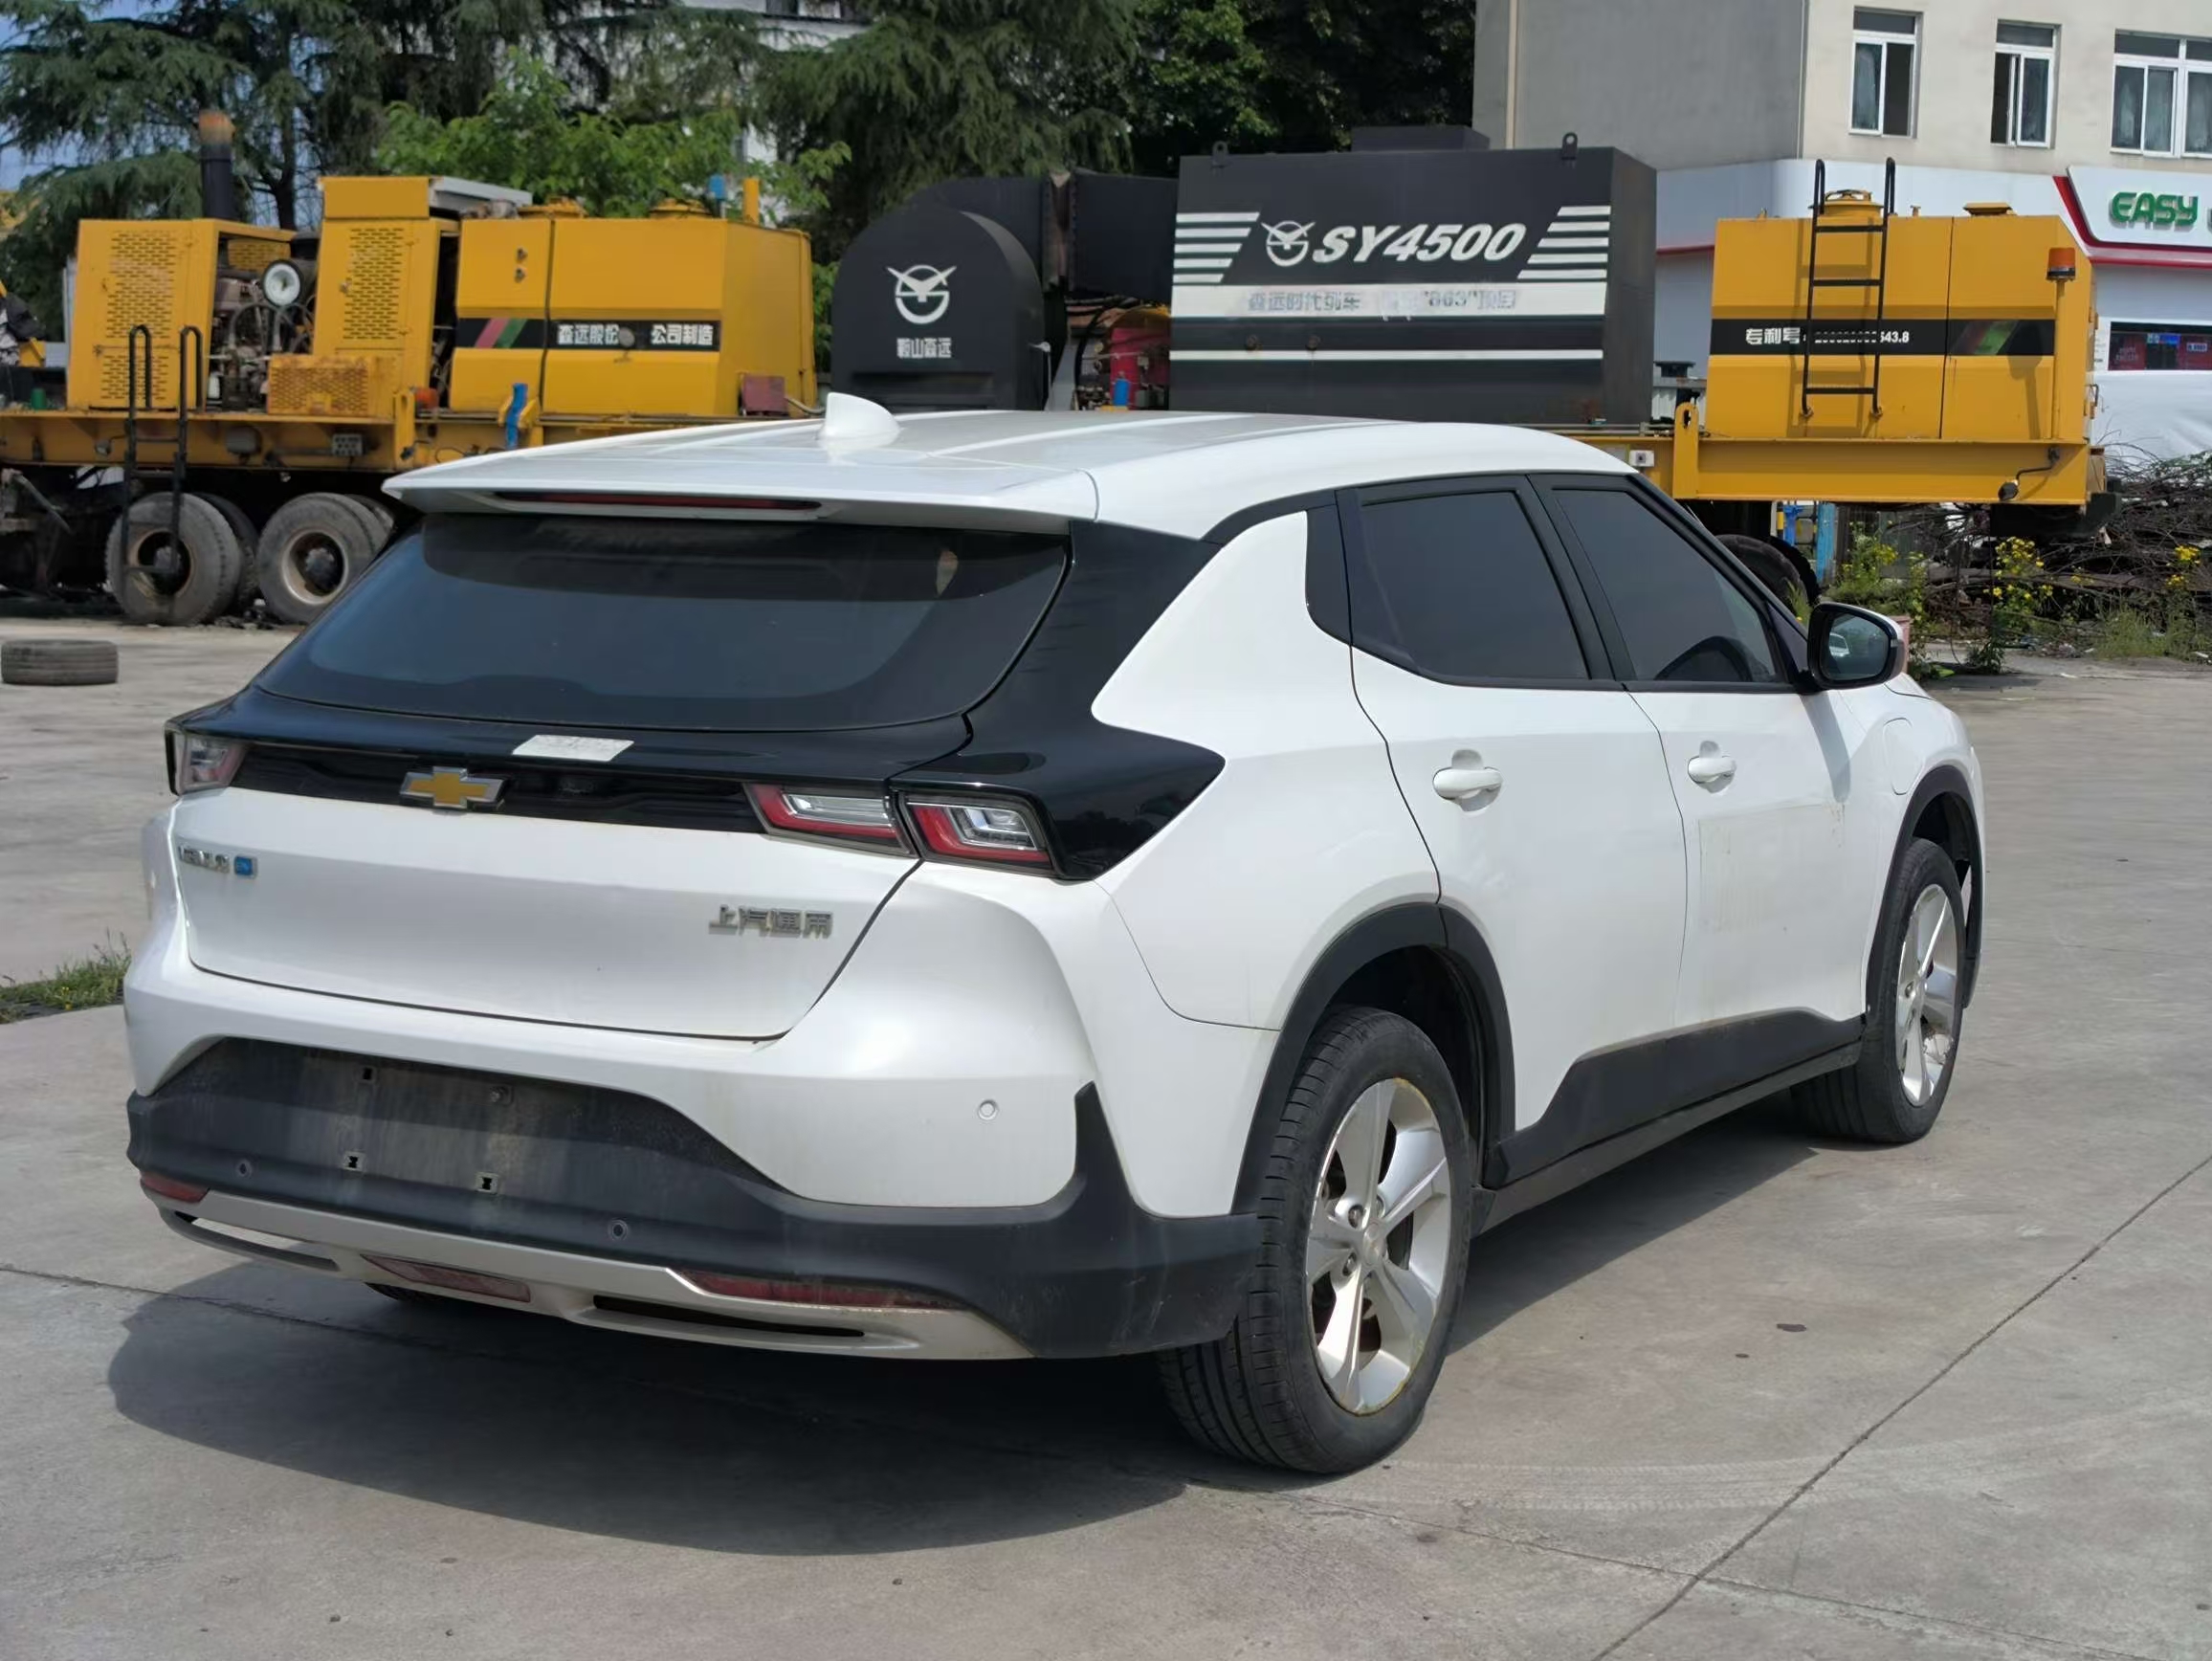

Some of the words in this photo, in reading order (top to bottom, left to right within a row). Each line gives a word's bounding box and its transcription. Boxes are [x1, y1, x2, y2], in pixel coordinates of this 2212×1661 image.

[2110, 191, 2199, 230] EASY
[1312, 223, 1527, 263] SY4500
[708, 903, 834, 941] 上汽通用
